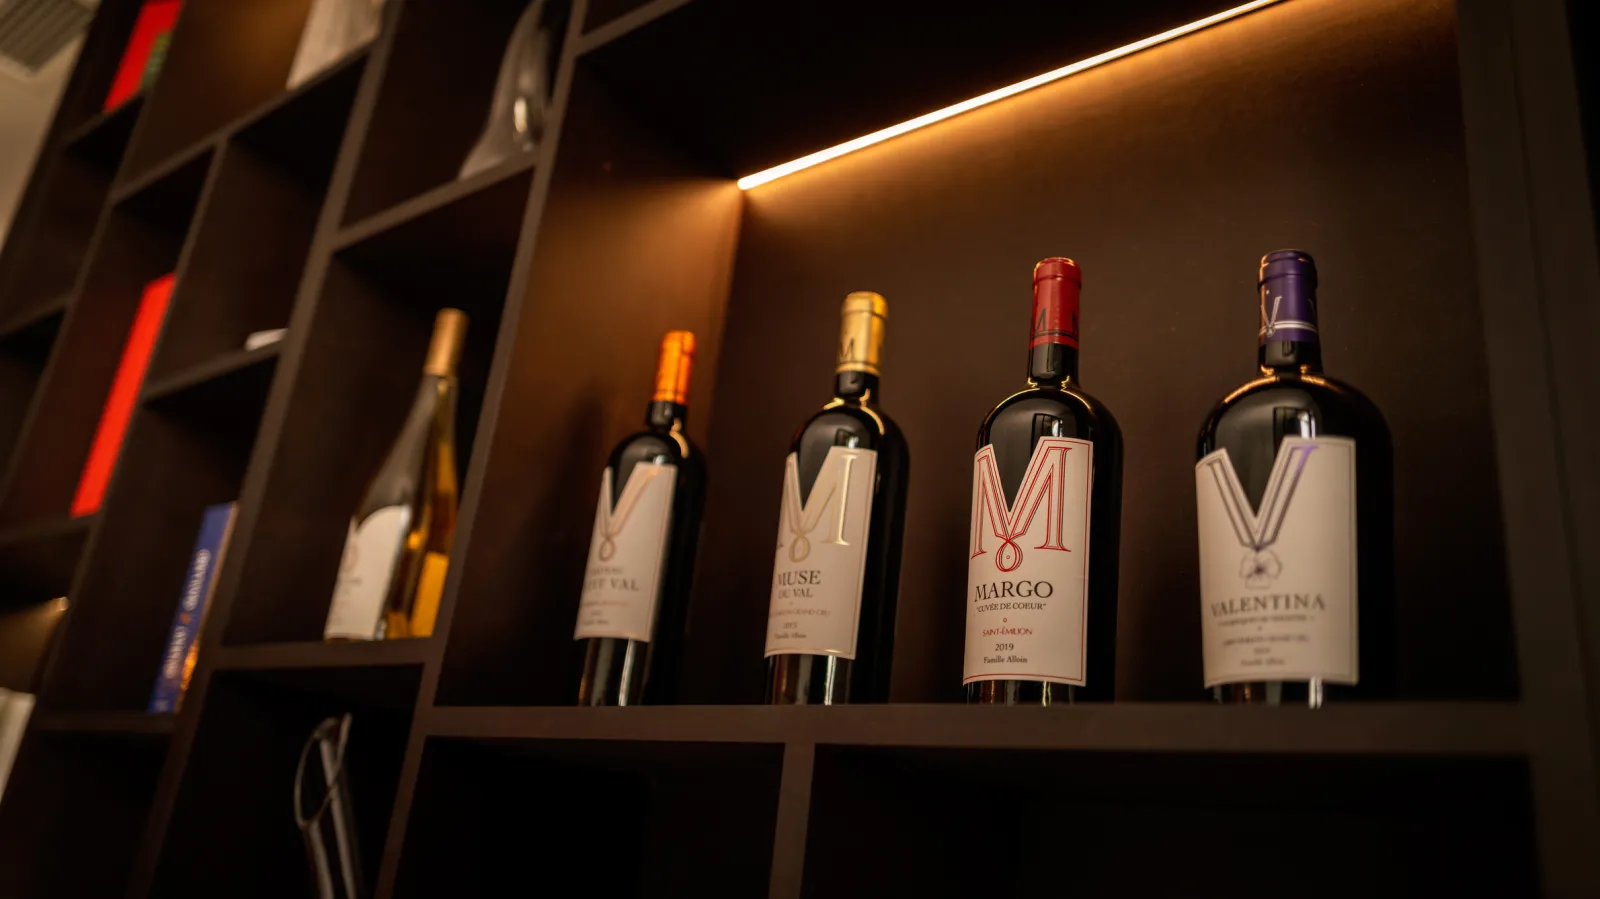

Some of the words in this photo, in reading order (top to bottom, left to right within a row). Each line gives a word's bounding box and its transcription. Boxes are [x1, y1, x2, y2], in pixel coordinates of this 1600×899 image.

[971, 447, 1072, 560] M
[776, 570, 821, 587] MUSE
[610, 578, 640, 592] VAL
[974, 580, 1053, 602] MARGO
[793, 588, 814, 598] VAL
[1000, 602, 1011, 610] DE
[1012, 602, 1046, 610] COEUR"
[1211, 594, 1326, 618] VALENTINA
[982, 626, 1033, 637] SAINT-ÉMILION
[995, 643, 1014, 652] 2019
[983, 655, 1005, 664] Famille
[1006, 655, 1028, 664] Alloin
